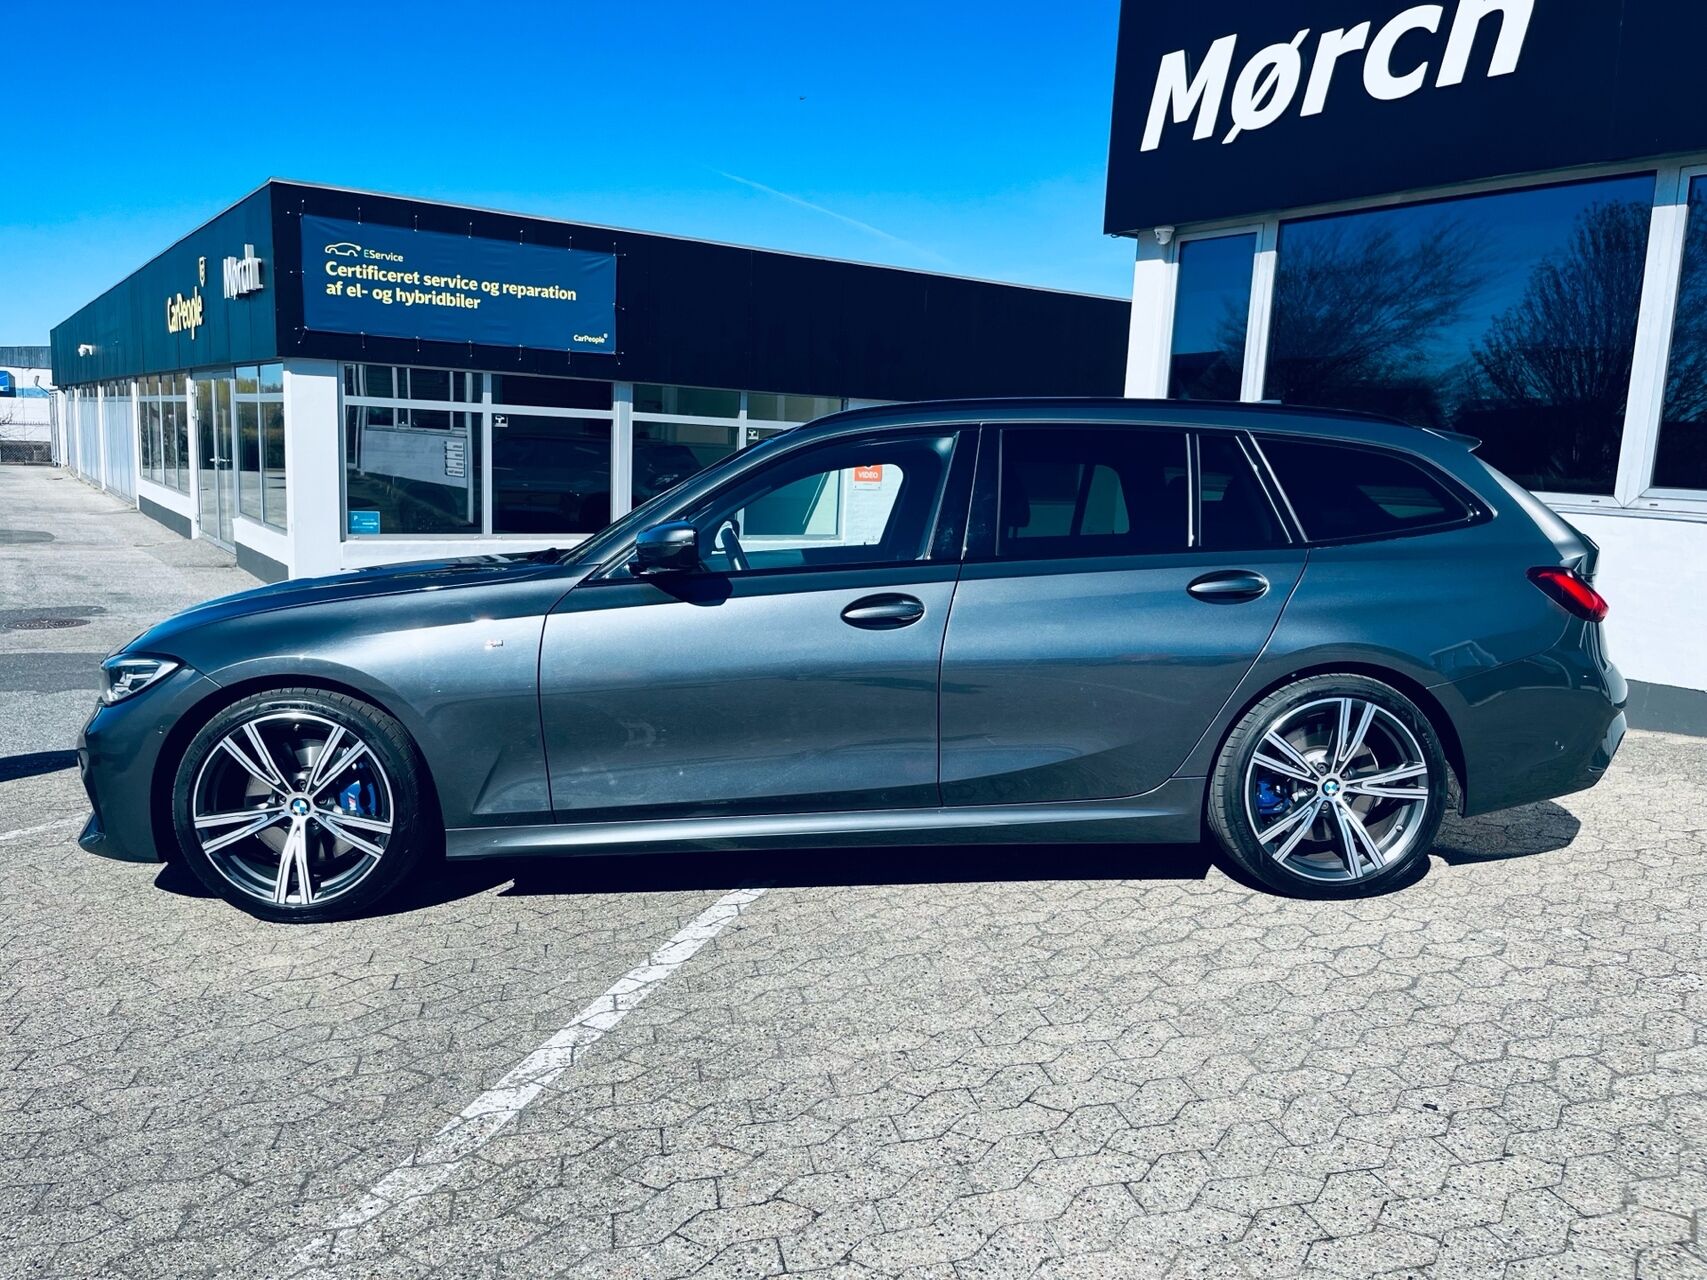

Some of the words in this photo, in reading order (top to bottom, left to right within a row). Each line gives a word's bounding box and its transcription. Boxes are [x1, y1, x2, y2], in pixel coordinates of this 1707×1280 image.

[1140, 0, 1535, 152] Mørch
[363, 249, 404, 262] EService
[325, 260, 420, 285] Certificeret
[423, 274, 478, 291] service
[481, 281, 500, 296] og
[502, 283, 577, 301] reparation
[326, 281, 343, 296] af
[346, 284, 369, 298] el-
[372, 288, 393, 305] og
[395, 287, 481, 309] hybridbiler
[573, 334, 605, 344] CarPeople
[857, 471, 879, 479] VIDEO
